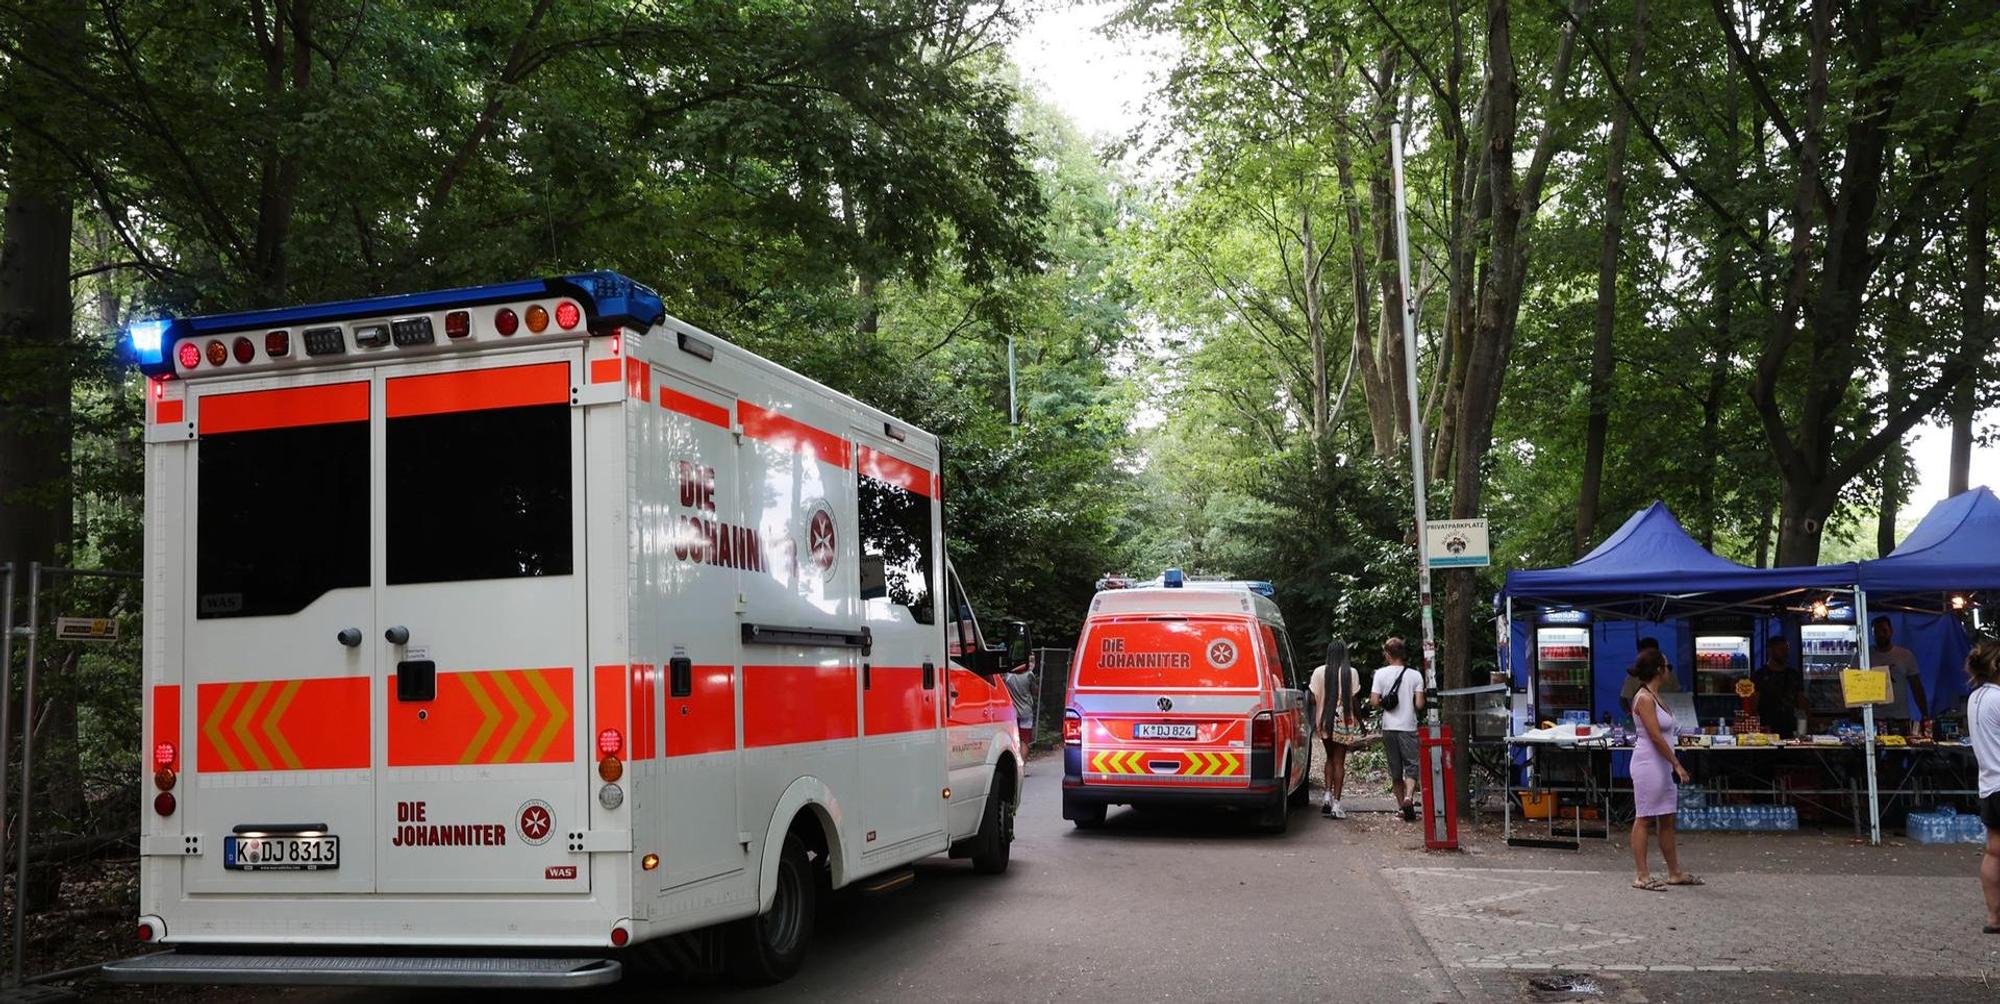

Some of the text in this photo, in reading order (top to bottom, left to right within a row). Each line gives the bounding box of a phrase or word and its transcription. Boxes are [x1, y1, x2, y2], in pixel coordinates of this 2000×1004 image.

[680, 460, 715, 512] DIE
[1102, 638, 1124, 653] DIE
[1098, 653, 1191, 669] JOHANNITER
[1142, 725, 1192, 736] K DJ 824
[397, 802, 426, 822] DIE
[393, 825, 506, 847] JOHANNITER
[237, 841, 249, 862] K
[261, 841, 284, 862] DJ
[289, 841, 335, 862] 8313
[549, 868, 573, 878] WAS
